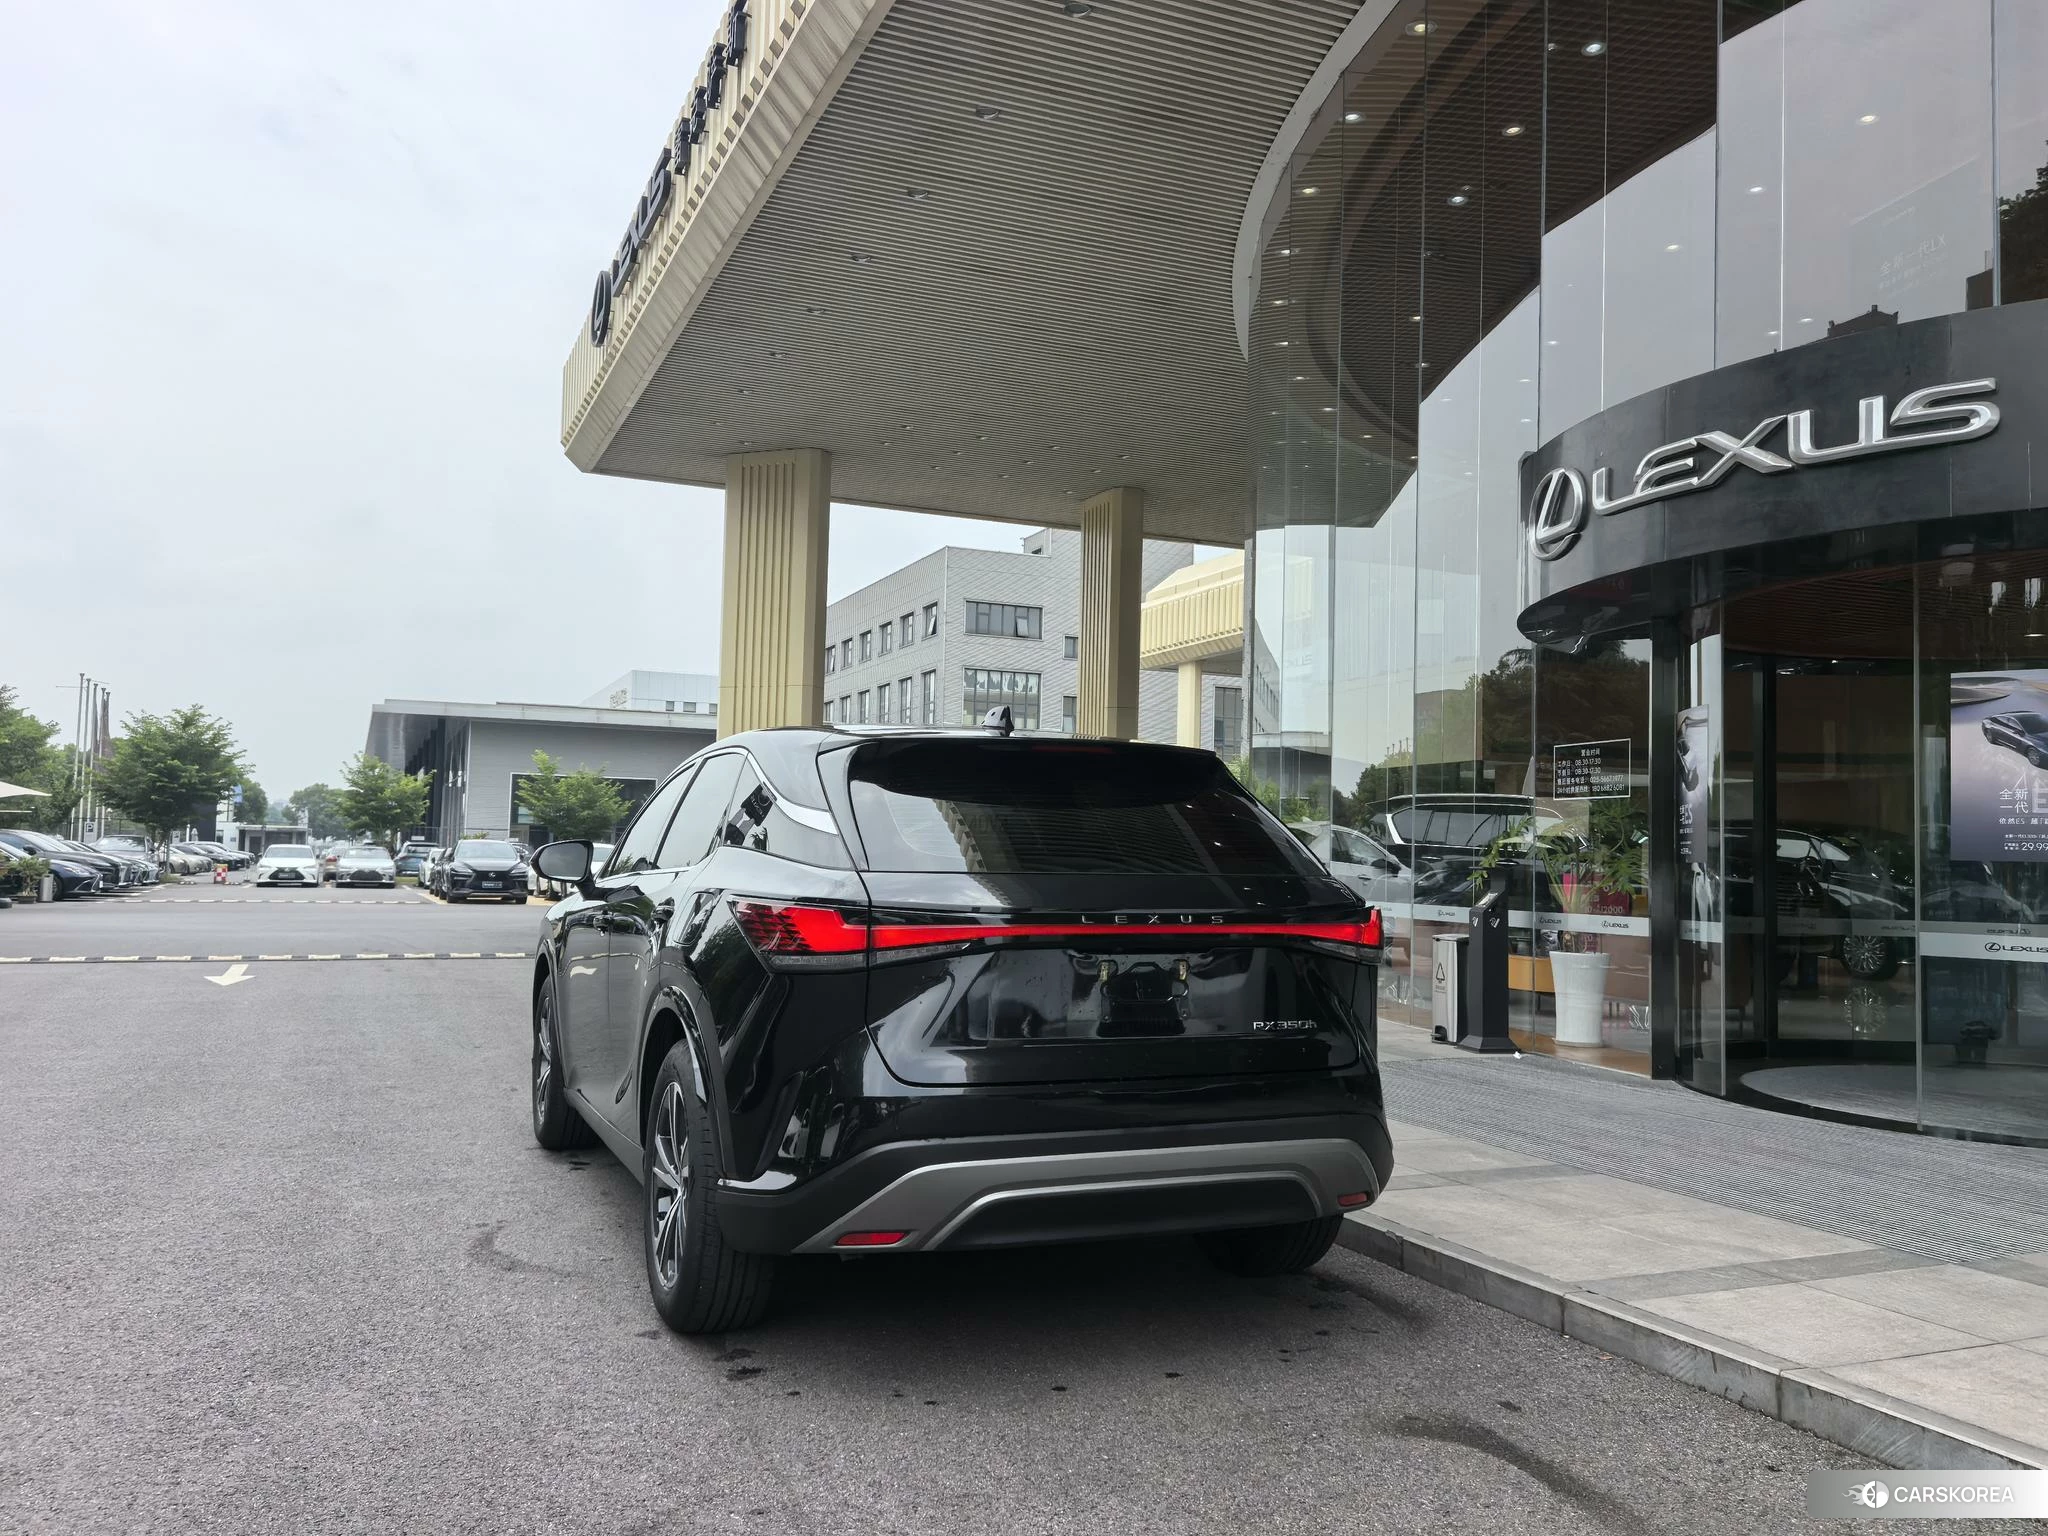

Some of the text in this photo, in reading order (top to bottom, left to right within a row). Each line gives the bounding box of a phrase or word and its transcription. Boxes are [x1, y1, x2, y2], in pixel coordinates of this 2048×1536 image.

[612, 147, 672, 298] LEXUS
[1592, 377, 2001, 516] LEXUS
[2000, 788, 2028, 801] 全新
[2000, 801, 2028, 814] 一代
[1081, 915, 1224, 924] LEXUS
